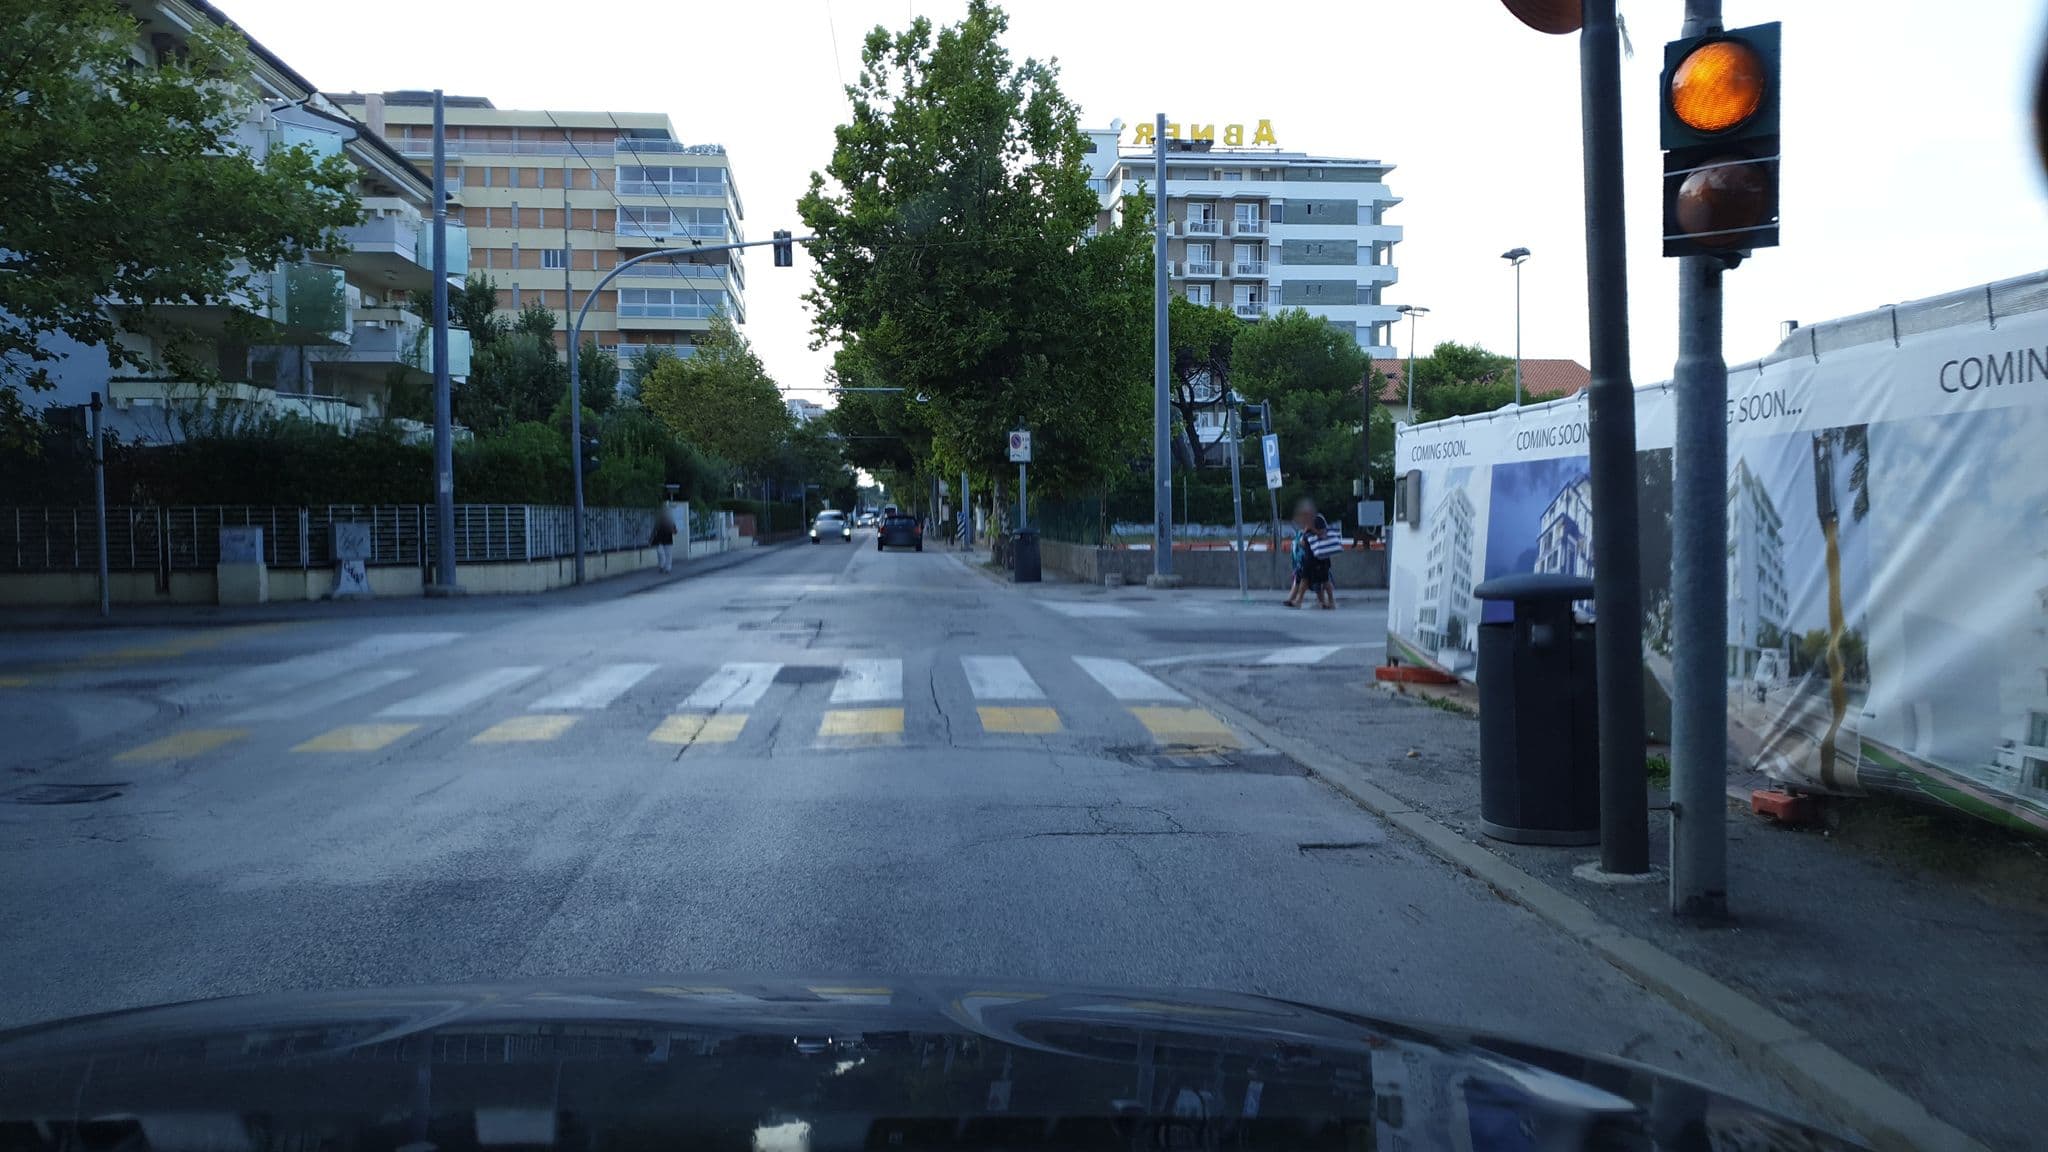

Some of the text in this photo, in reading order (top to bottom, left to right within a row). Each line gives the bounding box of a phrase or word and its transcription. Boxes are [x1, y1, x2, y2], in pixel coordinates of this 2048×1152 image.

[1940, 345, 2048, 393] COMIN
[1516, 426, 1557, 451] COMING
[1266, 439, 1276, 466] P
[1411, 442, 1441, 462] COMING
